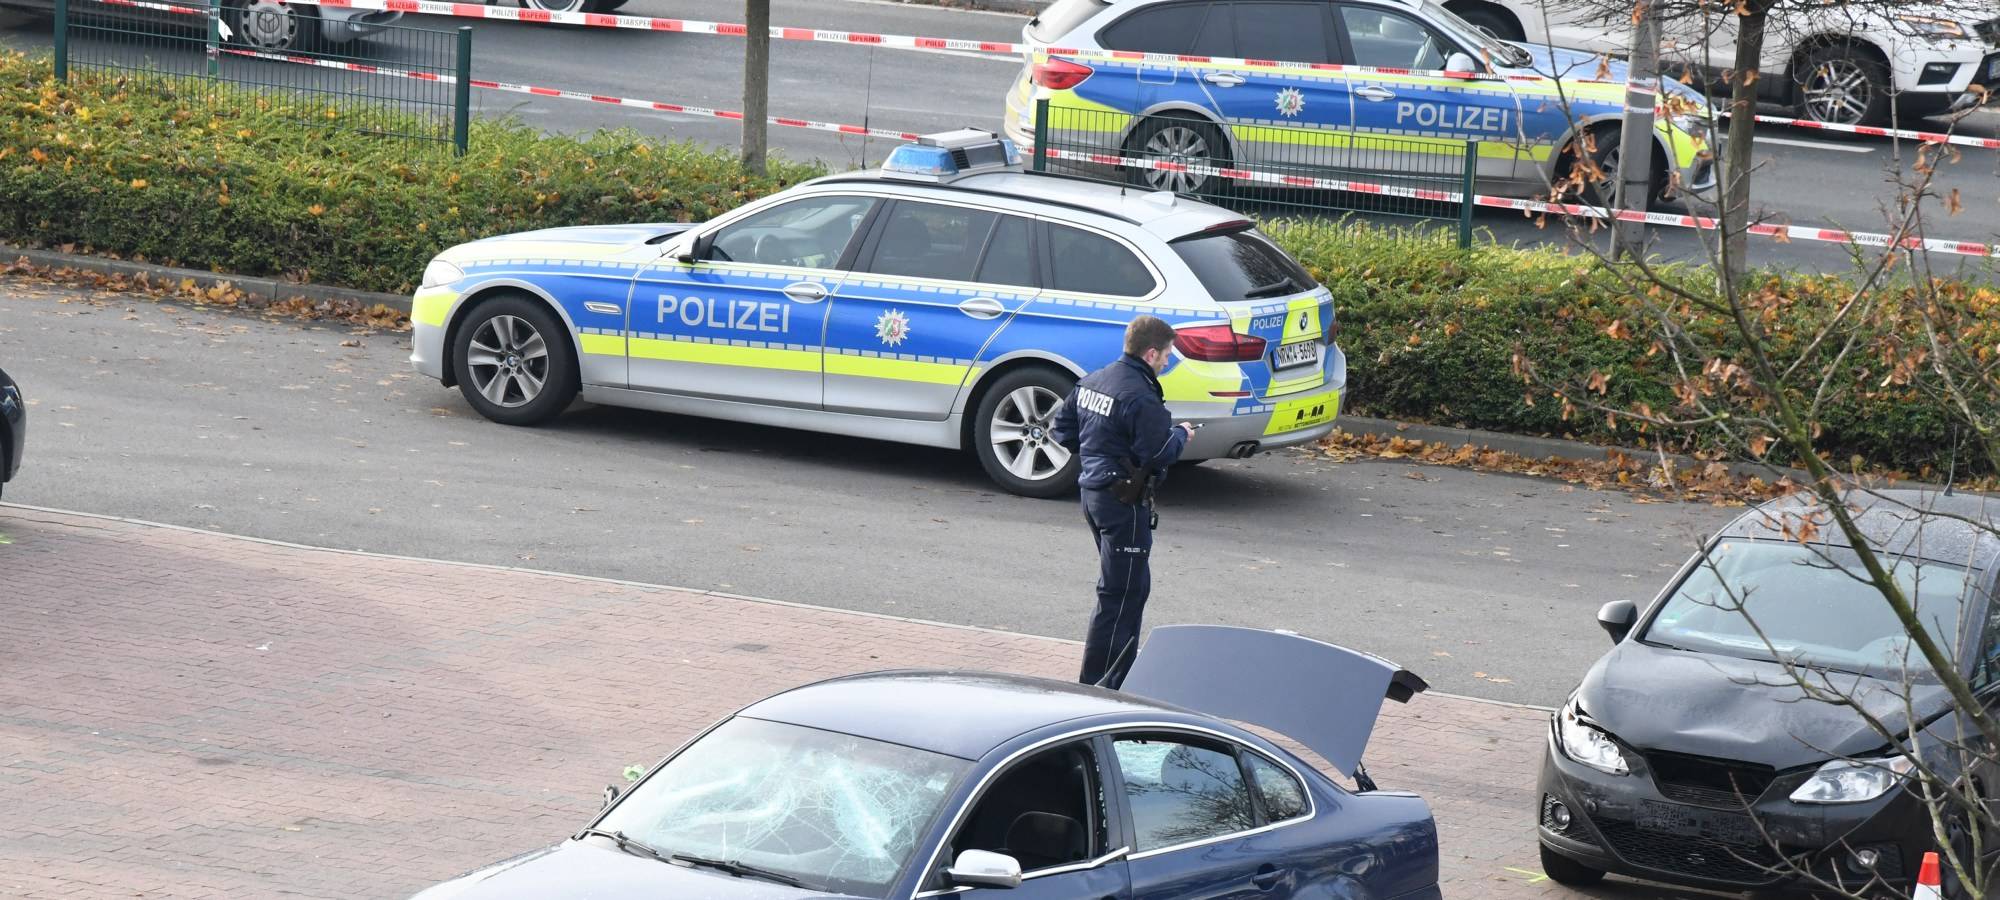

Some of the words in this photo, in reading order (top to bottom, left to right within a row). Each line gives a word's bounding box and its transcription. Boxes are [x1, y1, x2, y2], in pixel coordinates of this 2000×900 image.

[1396, 101, 1508, 131] POLIZEI
[657, 294, 790, 333] POLIZEI
[1252, 315, 1284, 331] POLIZEI
[1077, 386, 1114, 417] POLIZEI
